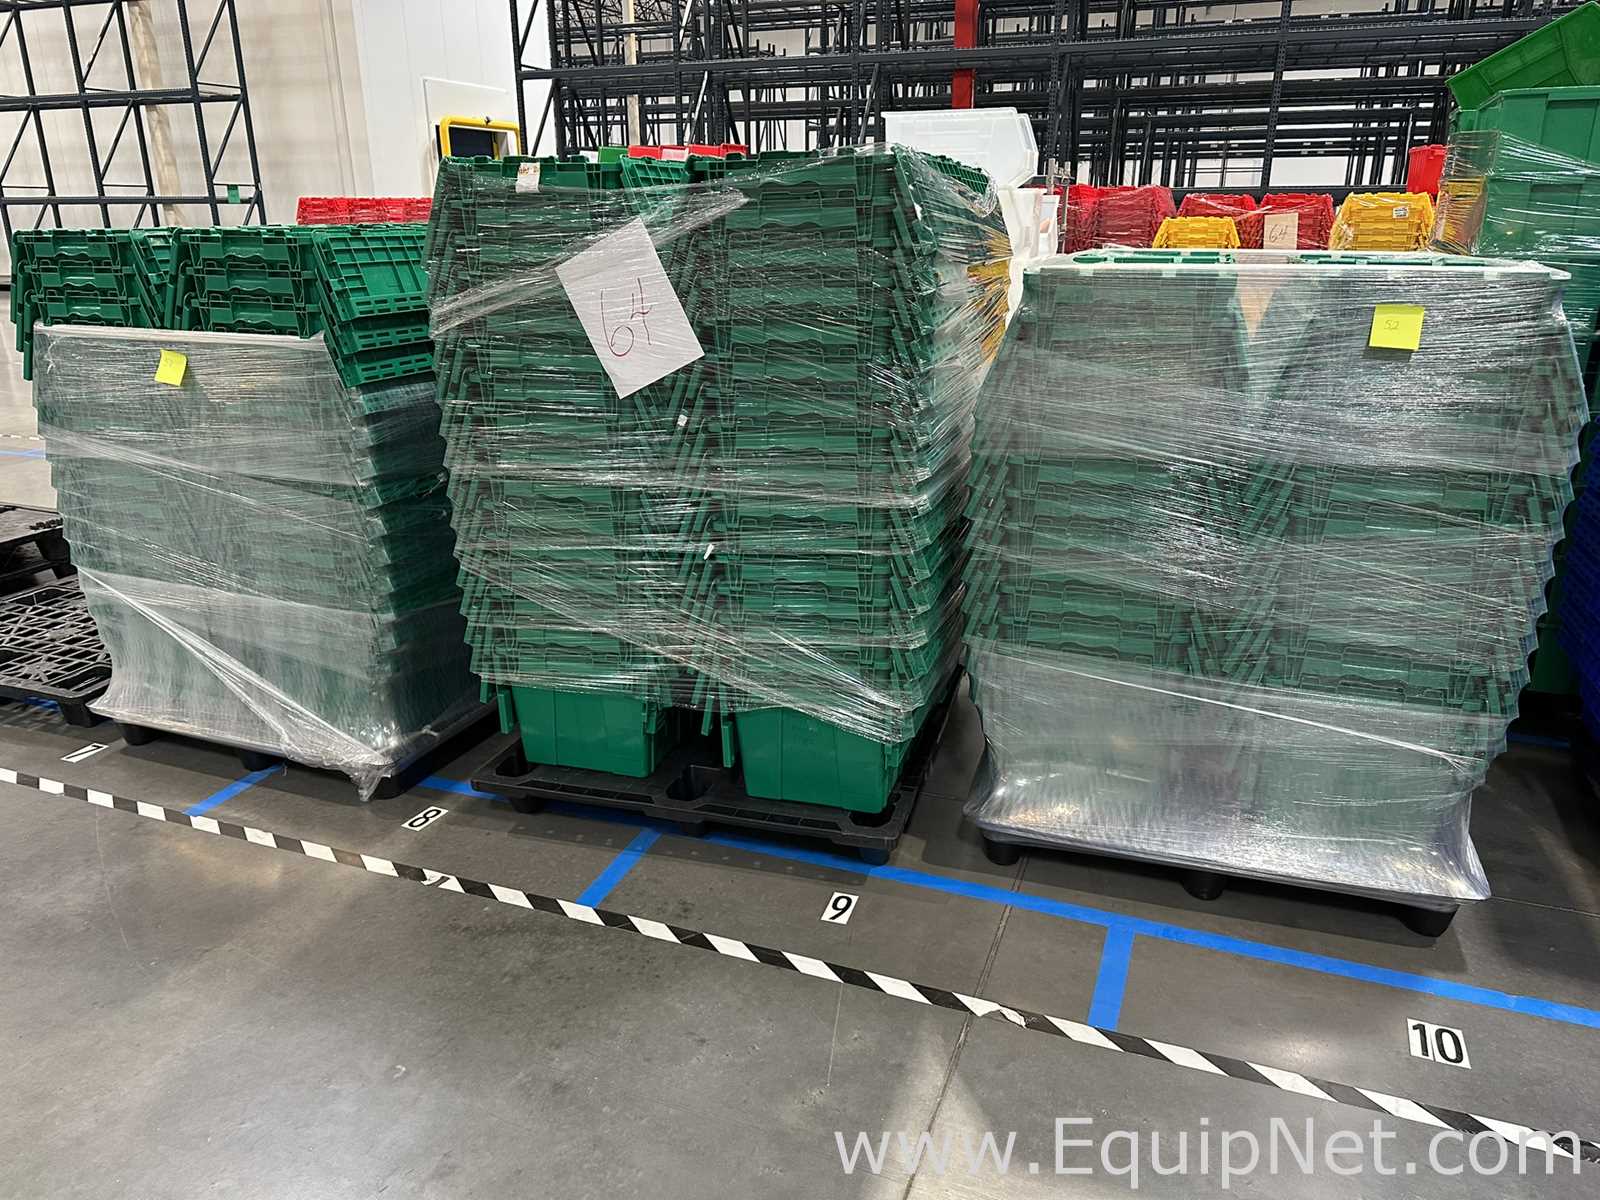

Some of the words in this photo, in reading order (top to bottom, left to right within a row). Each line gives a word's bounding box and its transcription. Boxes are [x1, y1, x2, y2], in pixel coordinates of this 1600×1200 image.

[1269, 223, 1289, 243] 64
[600, 277, 652, 357] 64
[65, 744, 104, 760] 7
[408, 809, 442, 828] 8
[829, 895, 853, 921] 9
[1412, 1023, 1464, 1064] 10
